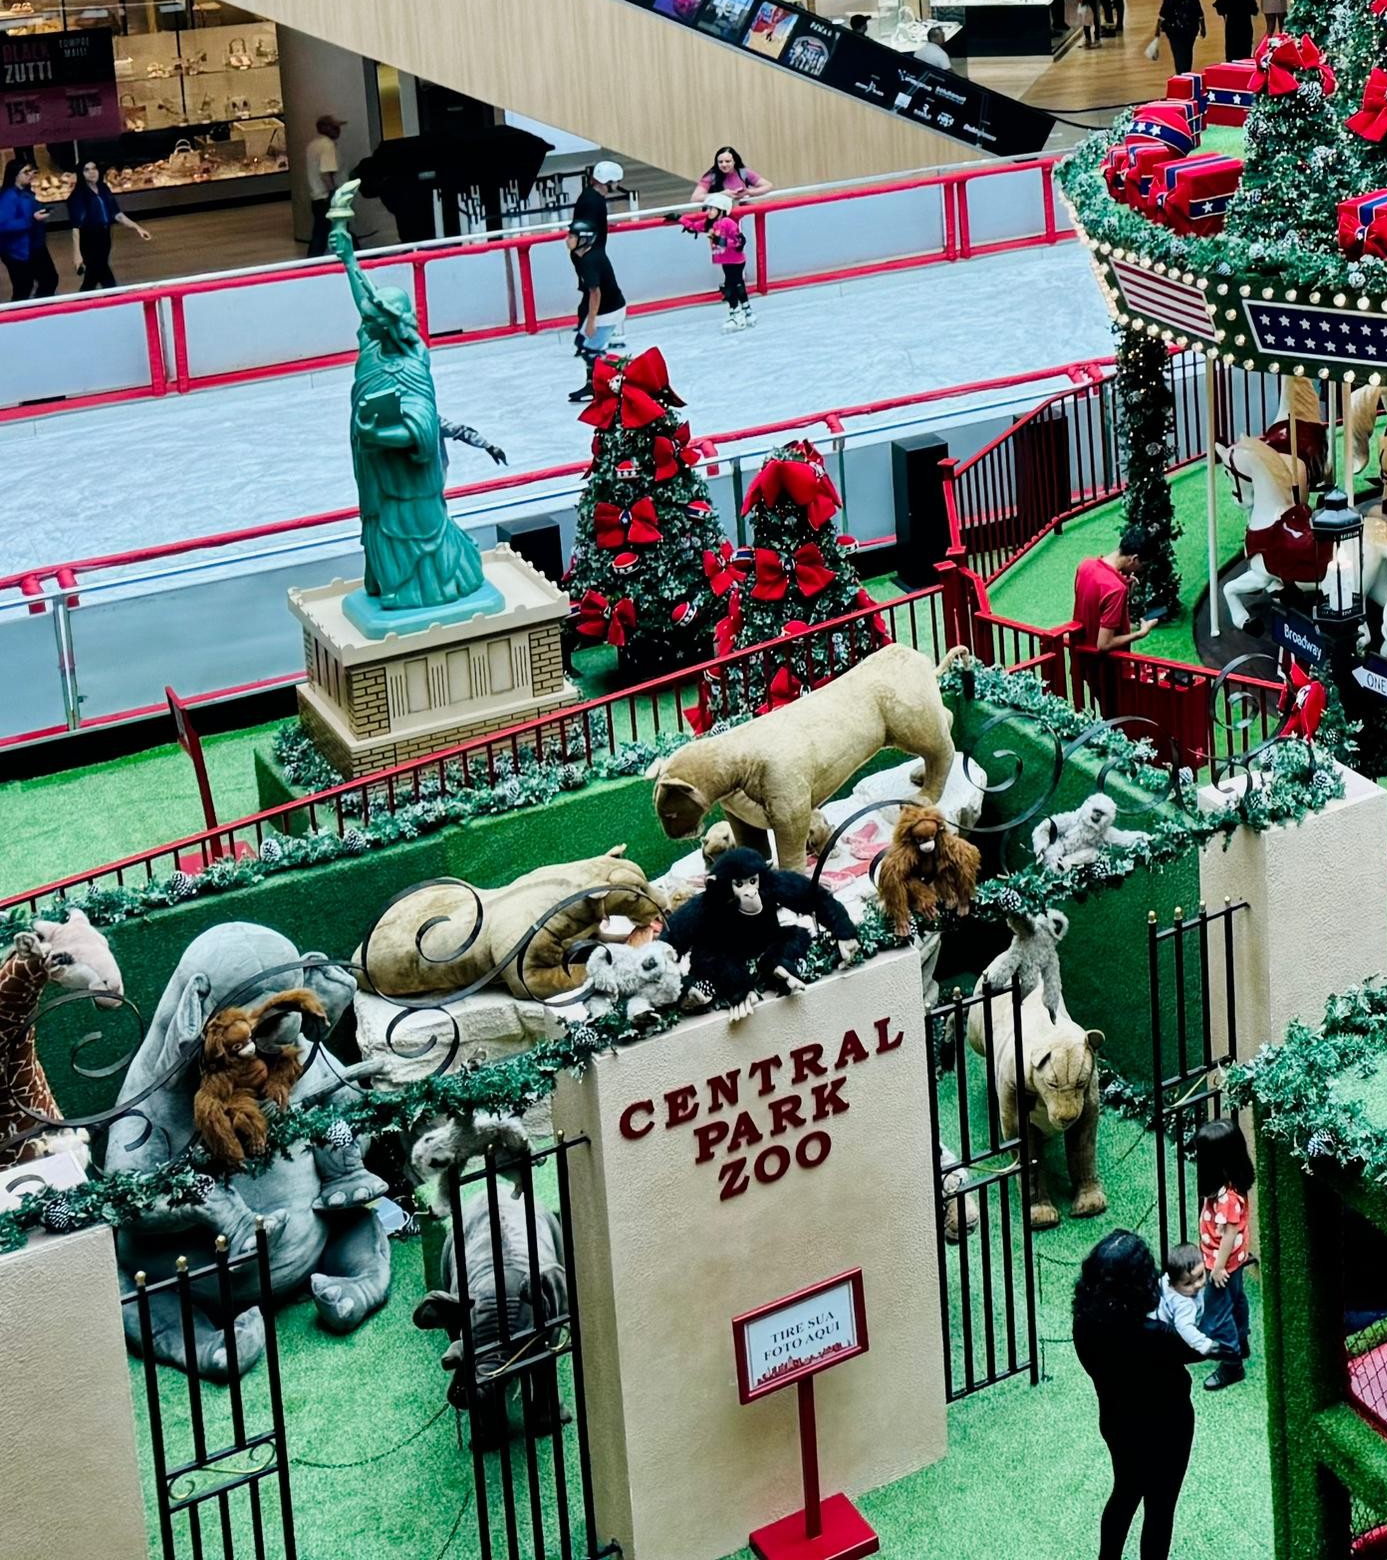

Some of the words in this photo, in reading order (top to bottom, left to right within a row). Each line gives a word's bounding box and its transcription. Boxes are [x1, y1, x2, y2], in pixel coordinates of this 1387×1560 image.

[4, 60, 53, 84] ZUTTI
[1283, 623, 1323, 661] Broadway
[1366, 673, 1387, 694] ONE
[619, 1017, 904, 1140] CENTRAL
[693, 1076, 850, 1164] PARK
[718, 1130, 832, 1201] ZOO
[764, 1338, 802, 1361] FOTO
[805, 1320, 840, 1344] AQUI
[770, 1322, 804, 1344] TIRE
[808, 1311, 834, 1329] SUA
